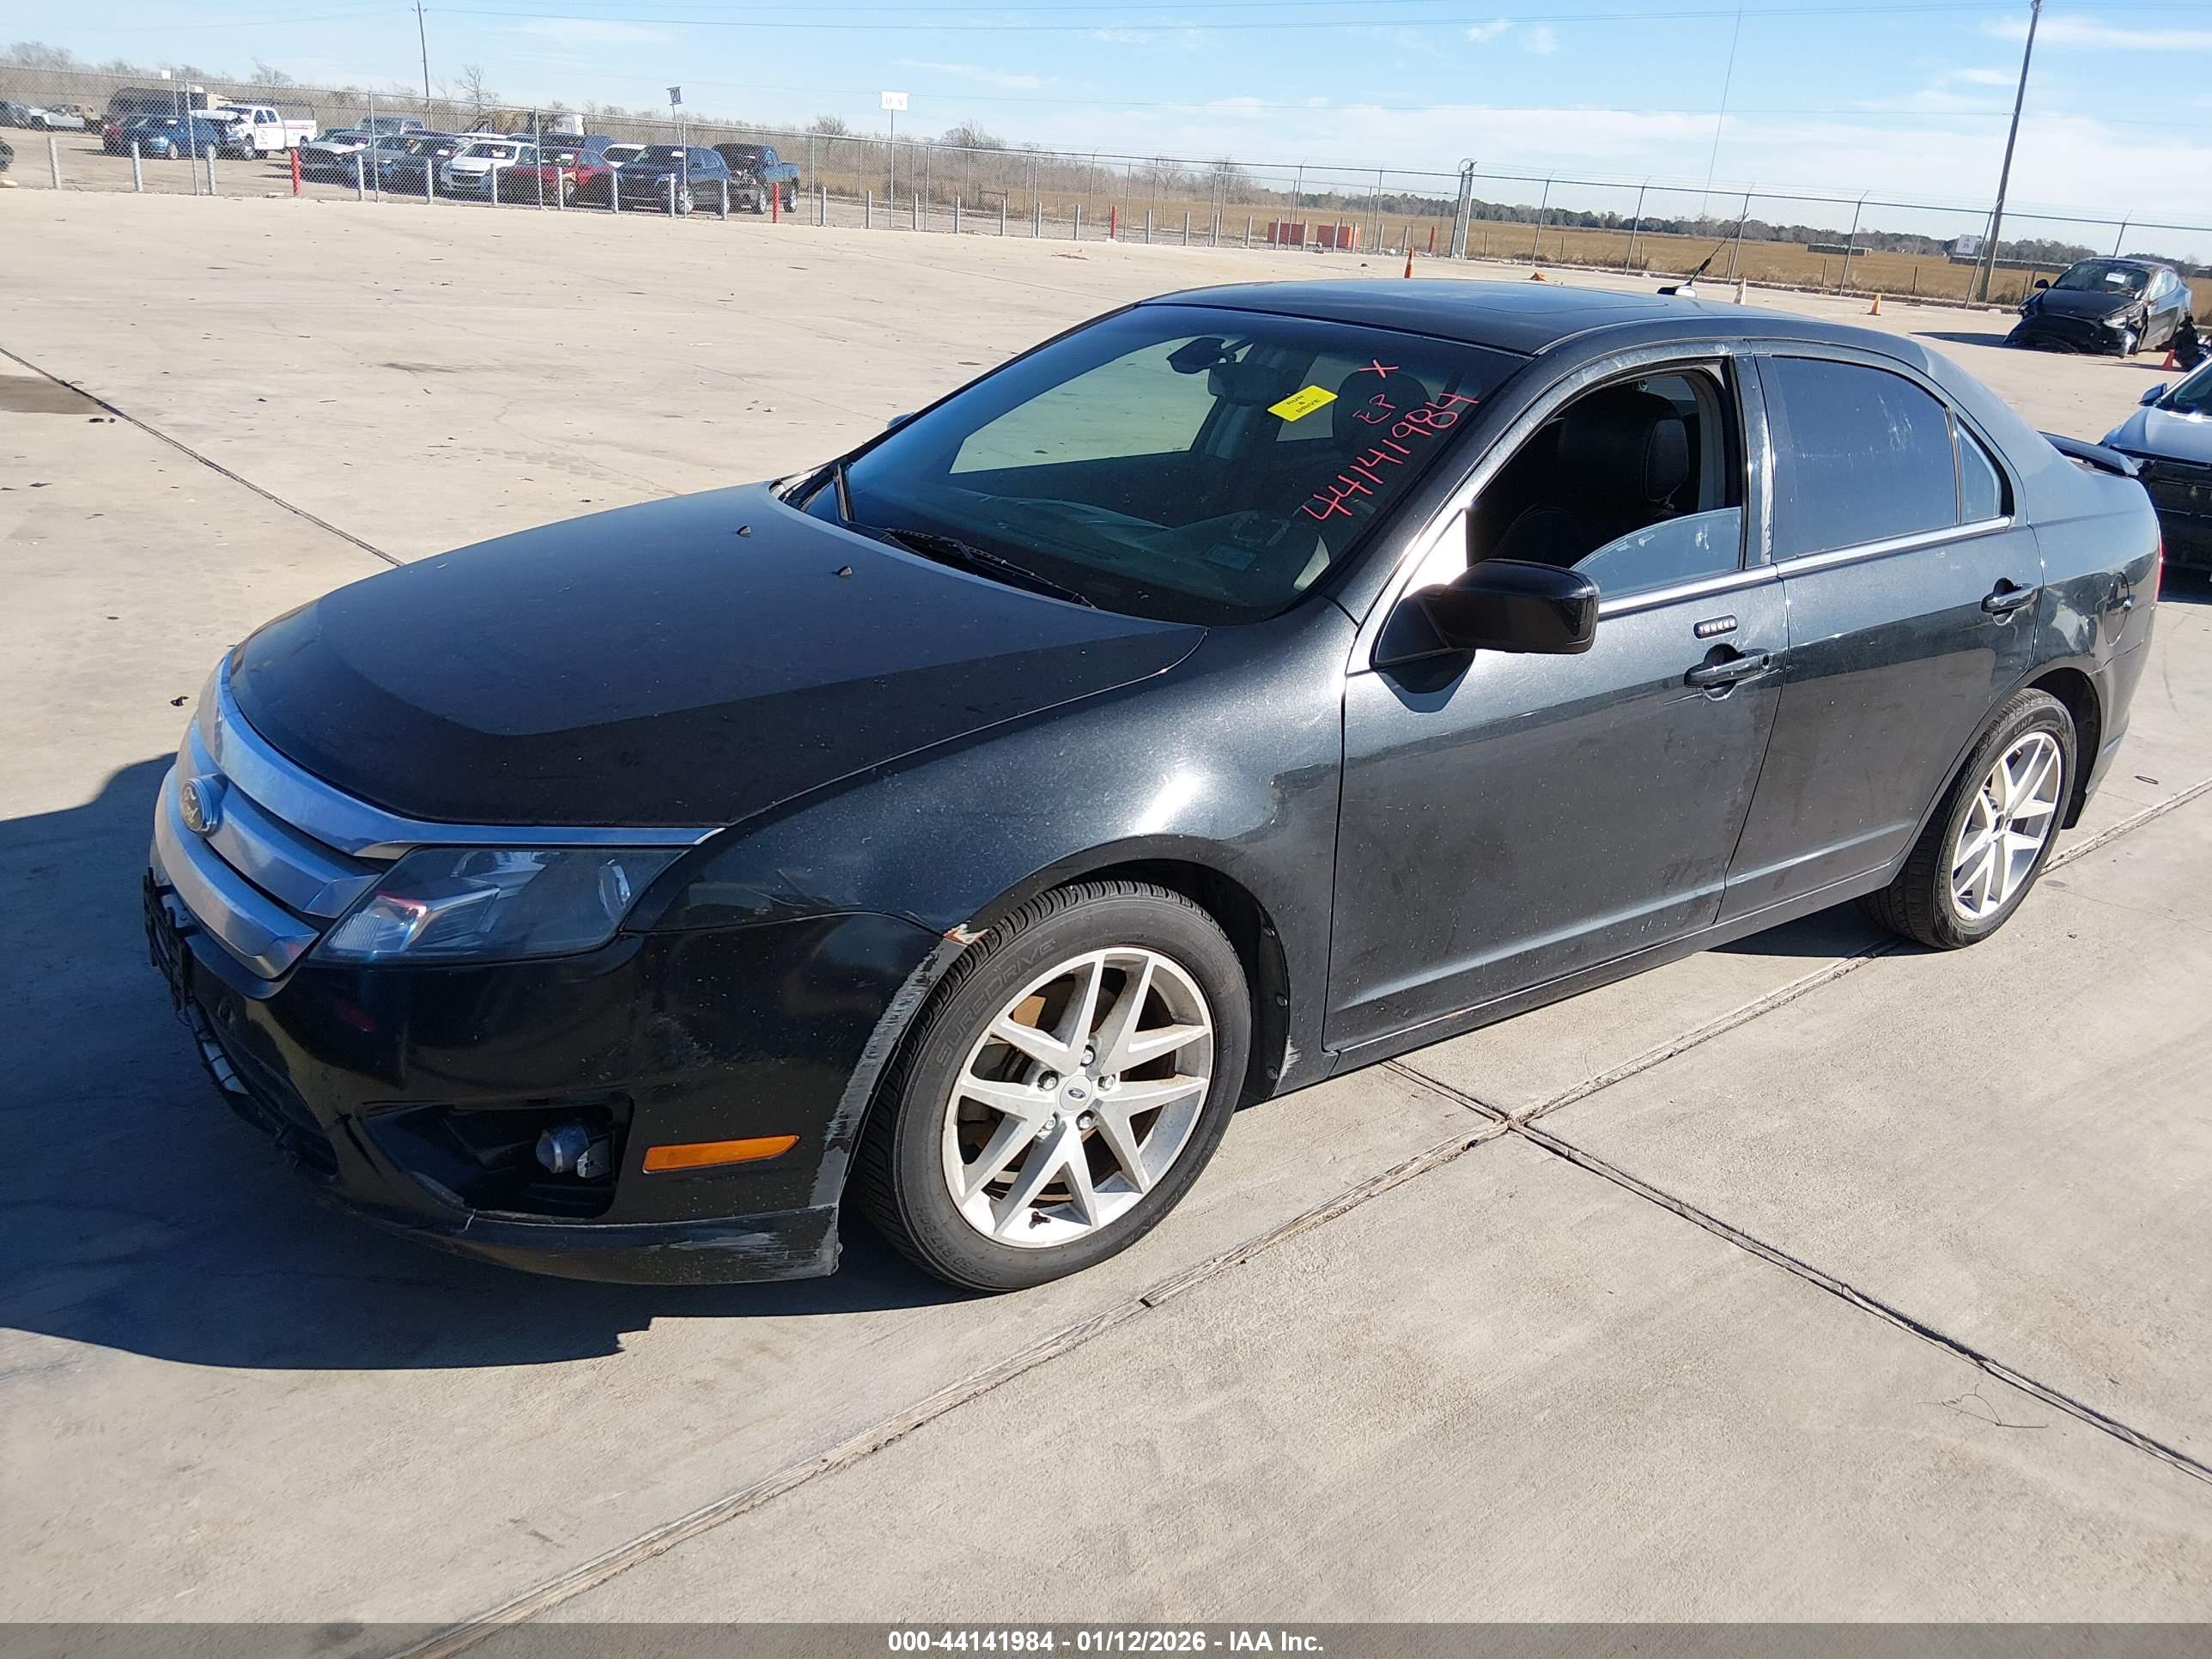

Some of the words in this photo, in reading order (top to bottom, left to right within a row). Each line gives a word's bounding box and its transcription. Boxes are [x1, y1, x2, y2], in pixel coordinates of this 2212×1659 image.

[671, 88, 681, 103] 20
[1286, 395, 1304, 405] RUN
[1295, 398, 1321, 413] DRIVE
[1302, 392, 1480, 520] 44141984
